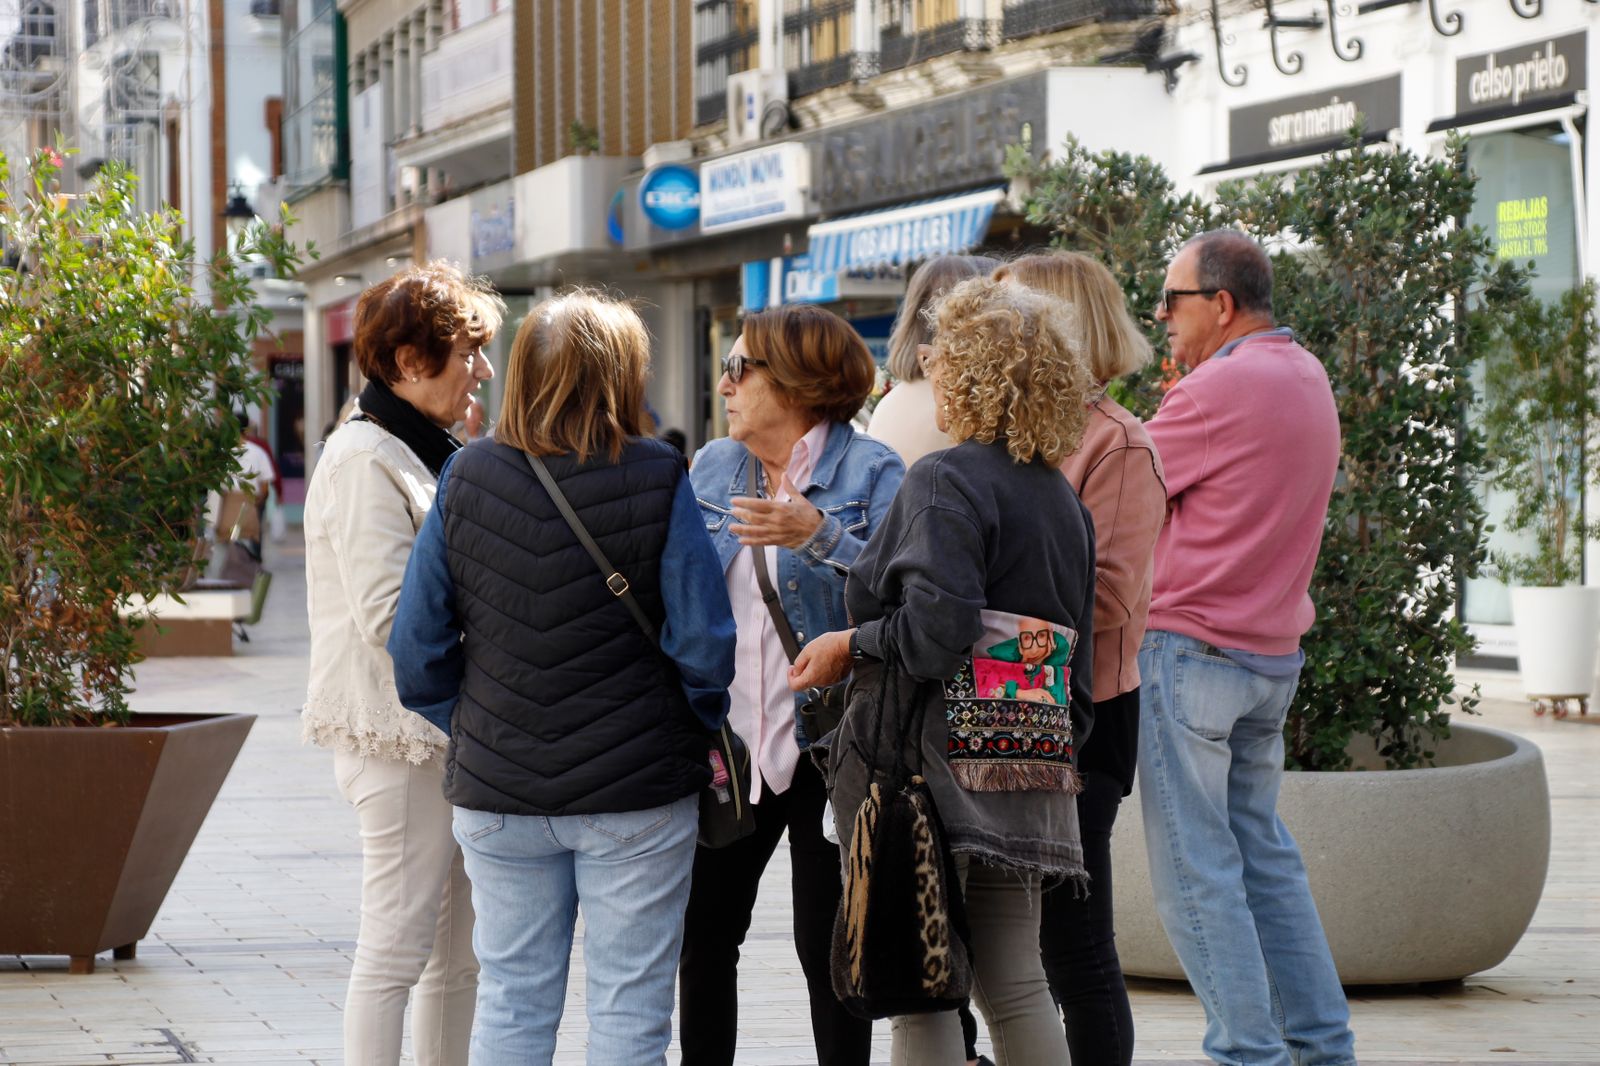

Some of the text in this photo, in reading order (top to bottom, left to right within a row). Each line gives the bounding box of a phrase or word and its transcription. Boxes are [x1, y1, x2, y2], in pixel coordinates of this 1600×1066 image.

[1469, 40, 1567, 106] celso prieto
[1268, 96, 1356, 146] sara merino
[1497, 195, 1548, 222] REBAJAS
[1498, 218, 1548, 240] FUERA STOCK
